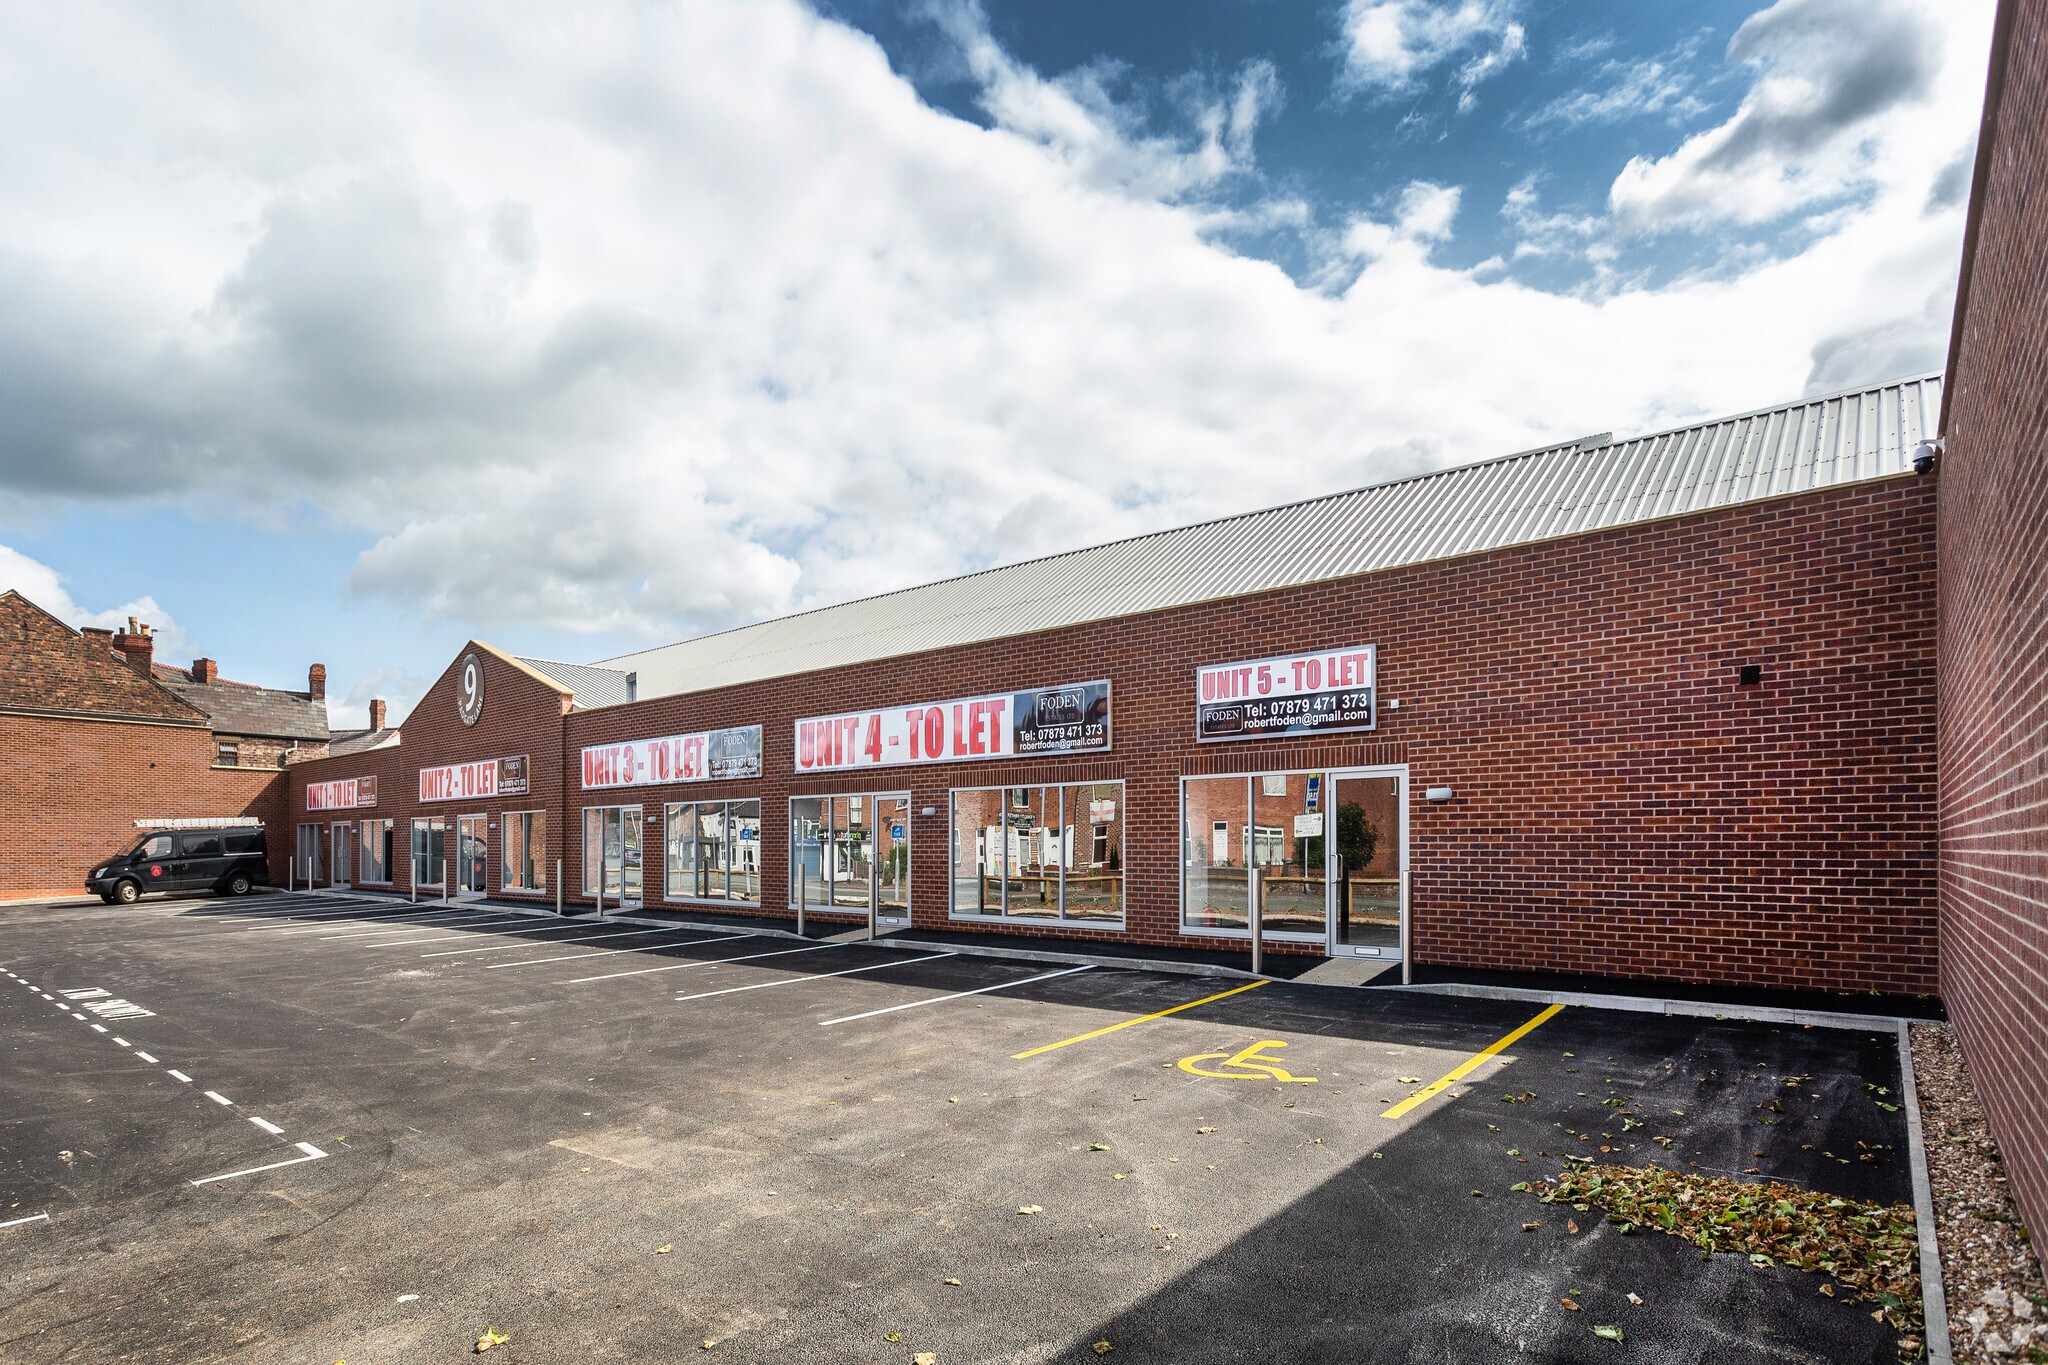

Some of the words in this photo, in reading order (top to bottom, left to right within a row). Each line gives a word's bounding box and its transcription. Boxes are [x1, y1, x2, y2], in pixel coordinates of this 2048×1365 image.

[464, 664, 476, 711] 9
[1202, 667, 1253, 701] UNIT
[1257, 665, 1272, 695] 5
[1291, 659, 1322, 692] TO
[1328, 653, 1368, 688] LET
[1040, 694, 1081, 711] FODEN
[1243, 704, 1267, 718] Tel:
[1270, 699, 1310, 715] 07879
[1313, 696, 1337, 712] 471
[1342, 693, 1368, 709] 373
[1206, 709, 1240, 722] FODEN
[1244, 710, 1368, 729] robertfoden@gmail.com
[723, 734, 746, 746] FODEN
[799, 717, 859, 769] UNIT
[864, 714, 883, 762] 4
[888, 736, 899, 746] -
[905, 706, 944, 760] TO
[953, 699, 1006, 757] LET
[1020, 730, 1036, 741] Tel:
[1038, 727, 1065, 740] 07879
[1066, 725, 1082, 738] 471
[1085, 724, 1103, 736] 373
[1020, 737, 1103, 750] robertfoden@gmail.com
[584, 747, 620, 786] UNIT
[623, 745, 634, 783] 3
[637, 762, 644, 770] -
[648, 741, 670, 780] TO
[674, 737, 705, 778] LET
[421, 769, 444, 799] UNIT
[446, 768, 453, 797] 2
[460, 765, 474, 796] TO
[476, 762, 495, 794] LET
[308, 784, 324, 809] UNIT
[325, 784, 328, 807] 1
[333, 782, 342, 807] TO
[343, 781, 355, 806] LET
